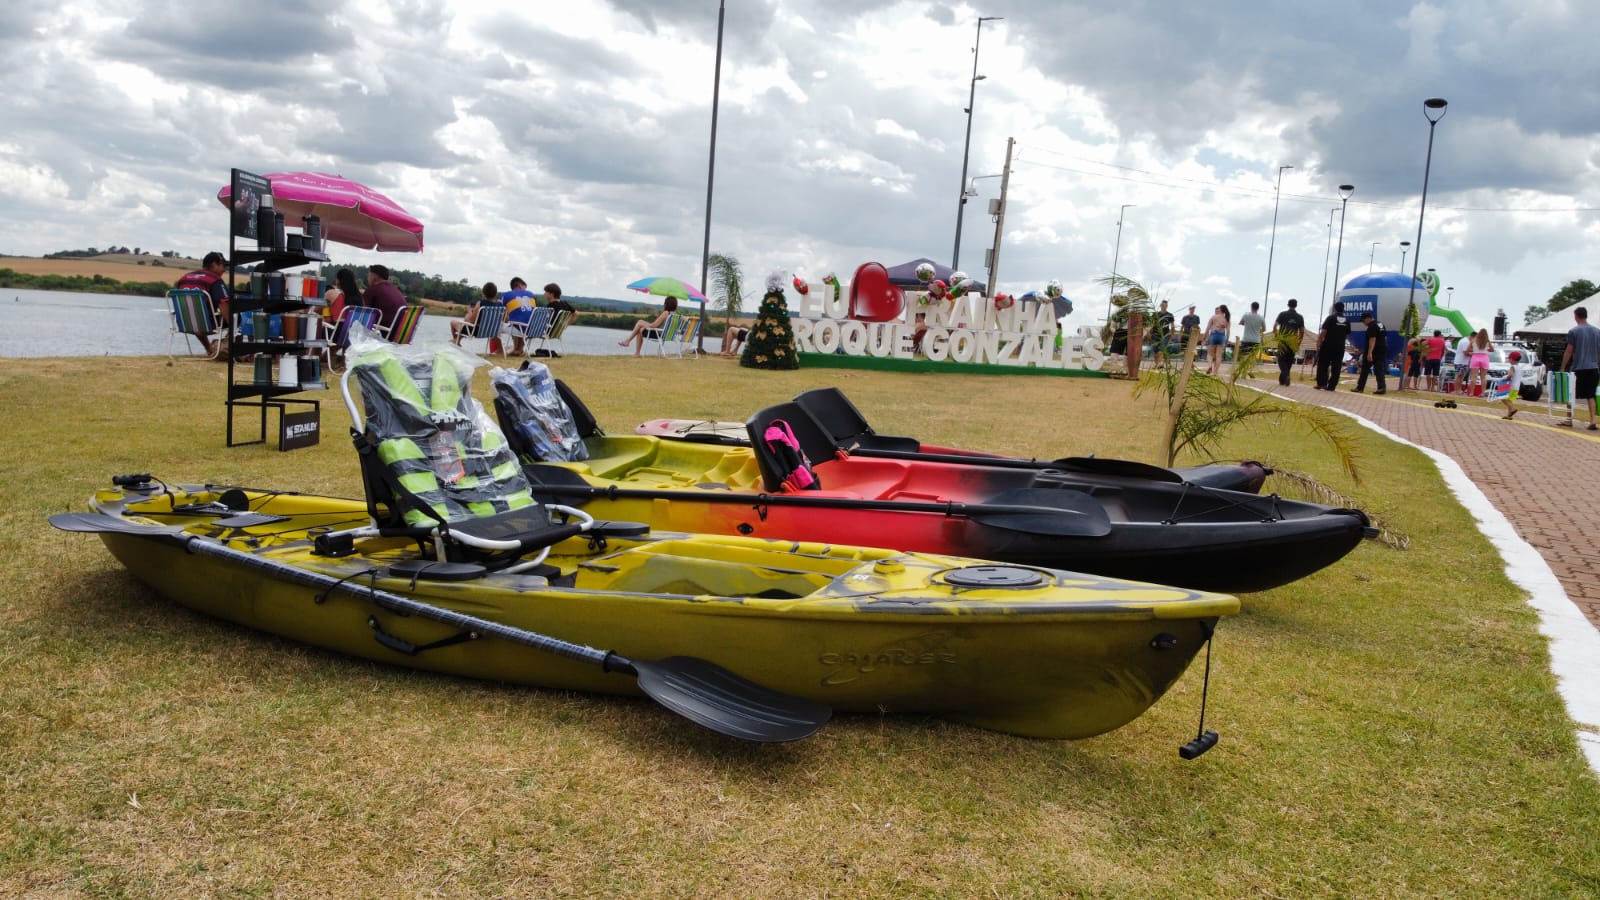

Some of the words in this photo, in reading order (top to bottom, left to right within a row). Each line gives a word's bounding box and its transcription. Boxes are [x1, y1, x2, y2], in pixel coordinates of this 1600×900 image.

[799, 284, 850, 320] EU
[791, 317, 914, 360] ROQUE
[922, 328, 1105, 371] GONZALES
